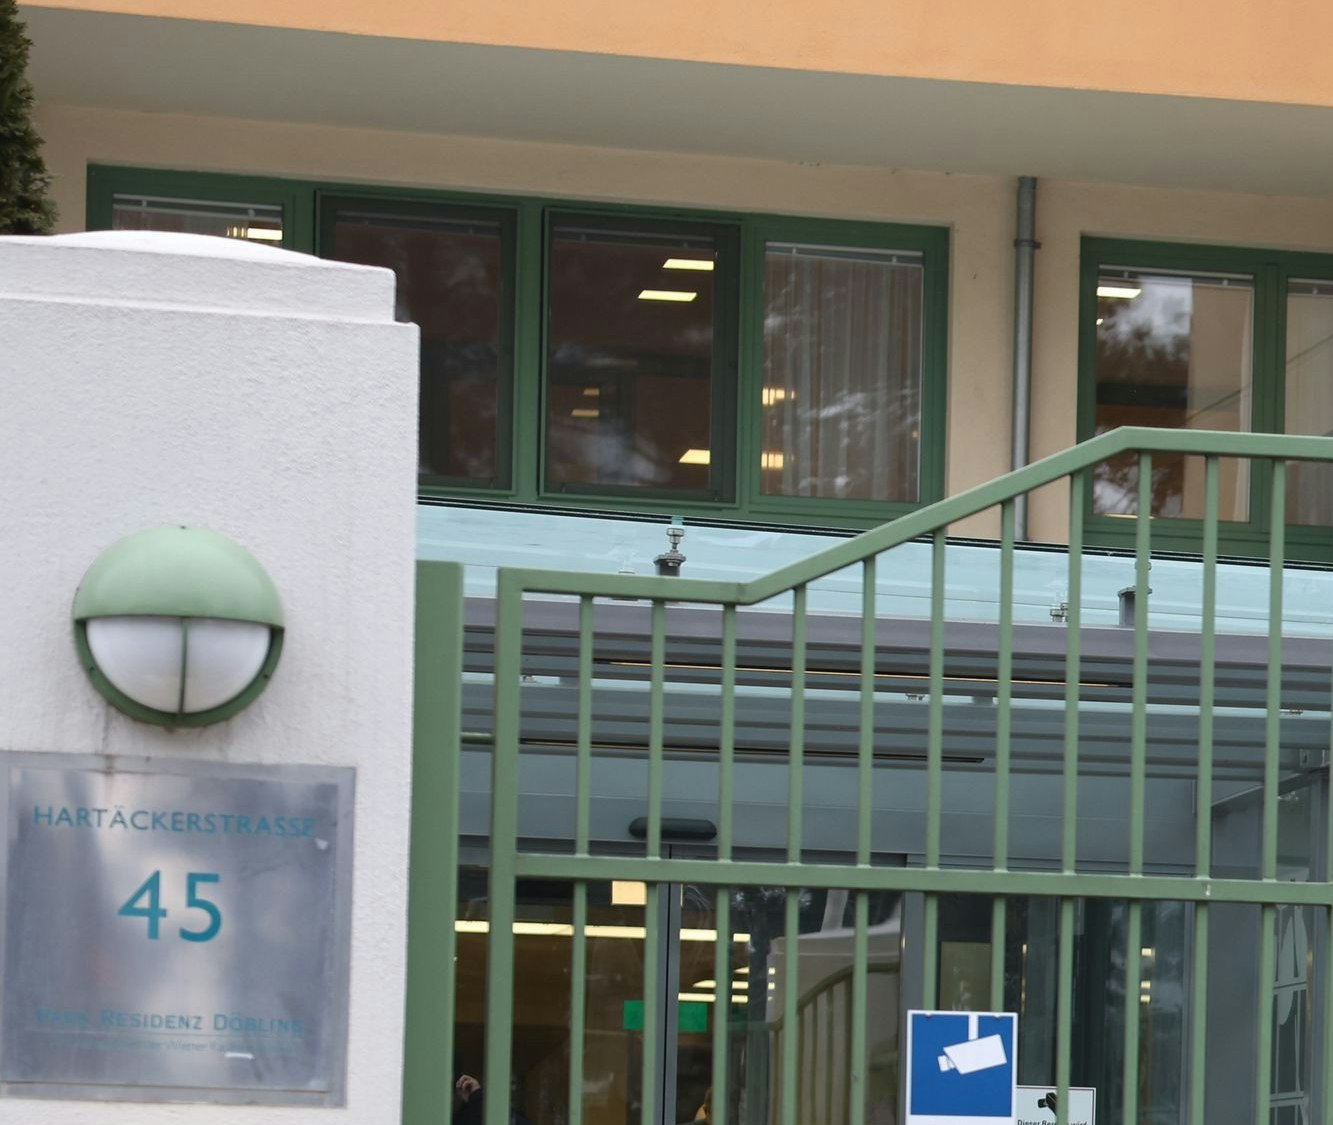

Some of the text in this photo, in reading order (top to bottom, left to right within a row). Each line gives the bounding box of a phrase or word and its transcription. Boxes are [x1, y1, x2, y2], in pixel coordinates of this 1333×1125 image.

[33, 804, 316, 839] HARTÄCKERSTRASSE
[117, 869, 223, 943] 45
[101, 1008, 203, 1031] RESIDENZ
